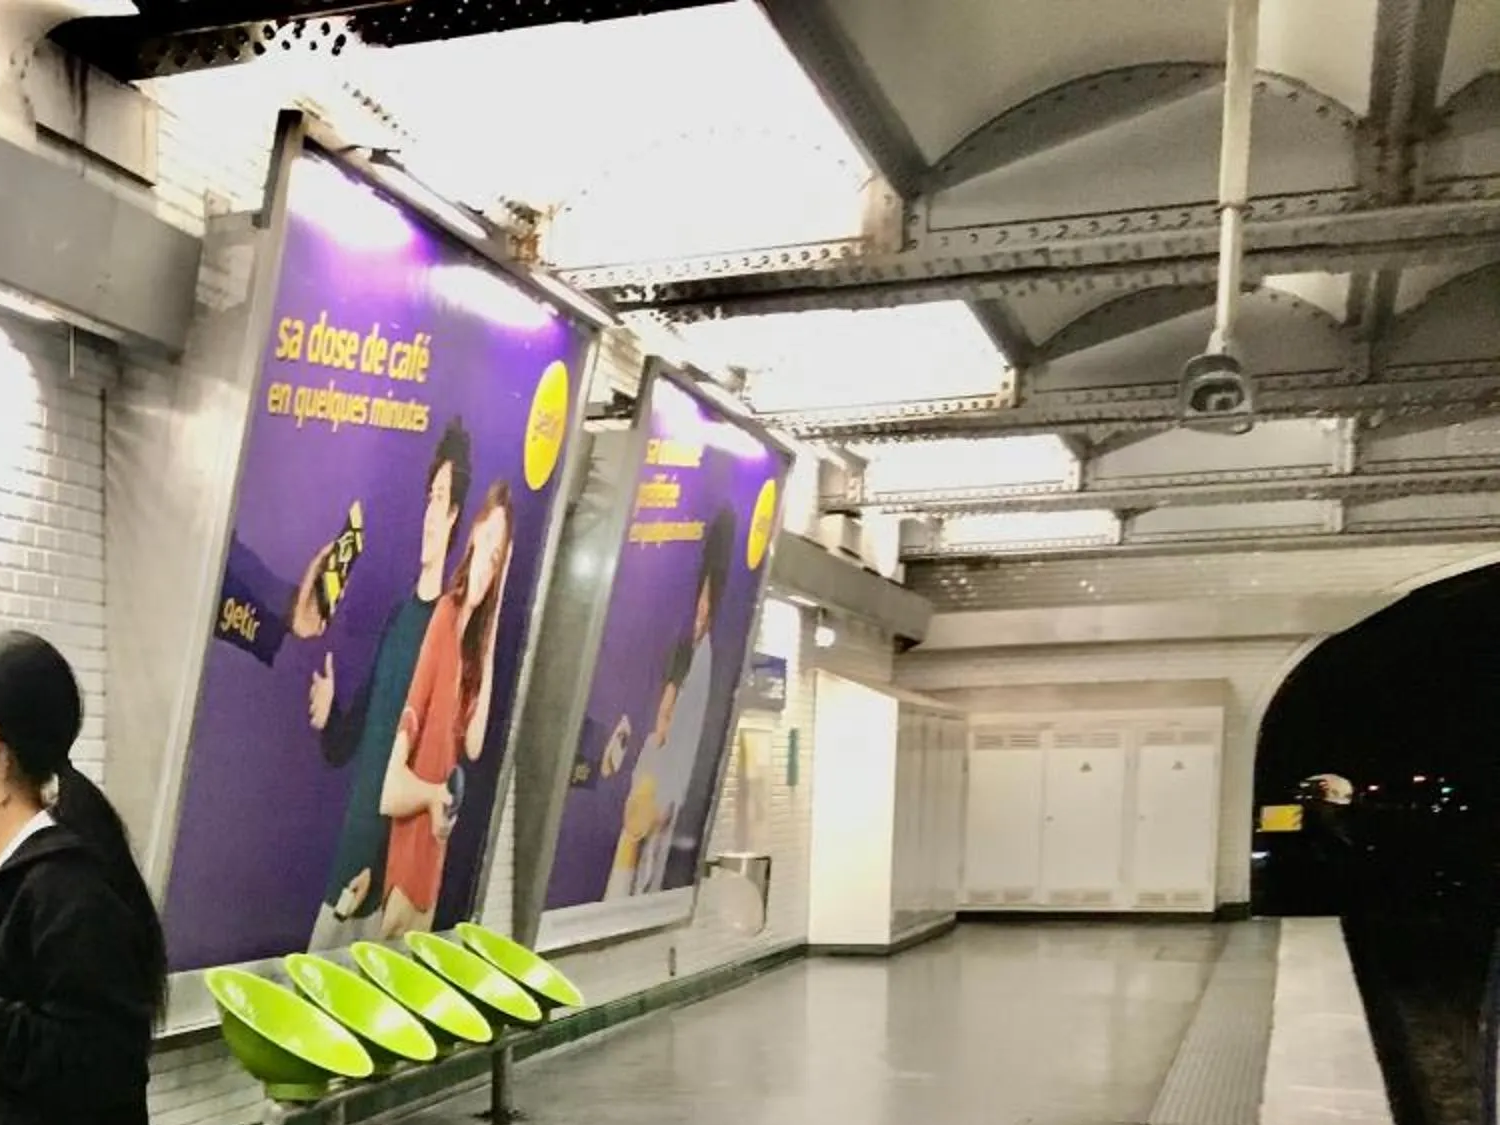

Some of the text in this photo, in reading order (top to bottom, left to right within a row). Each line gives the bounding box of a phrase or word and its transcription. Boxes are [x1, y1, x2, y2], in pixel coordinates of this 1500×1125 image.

[275, 310, 432, 383] sa dose de café
[267, 378, 431, 433] en quelques minutes
[219, 598, 261, 643] getir
